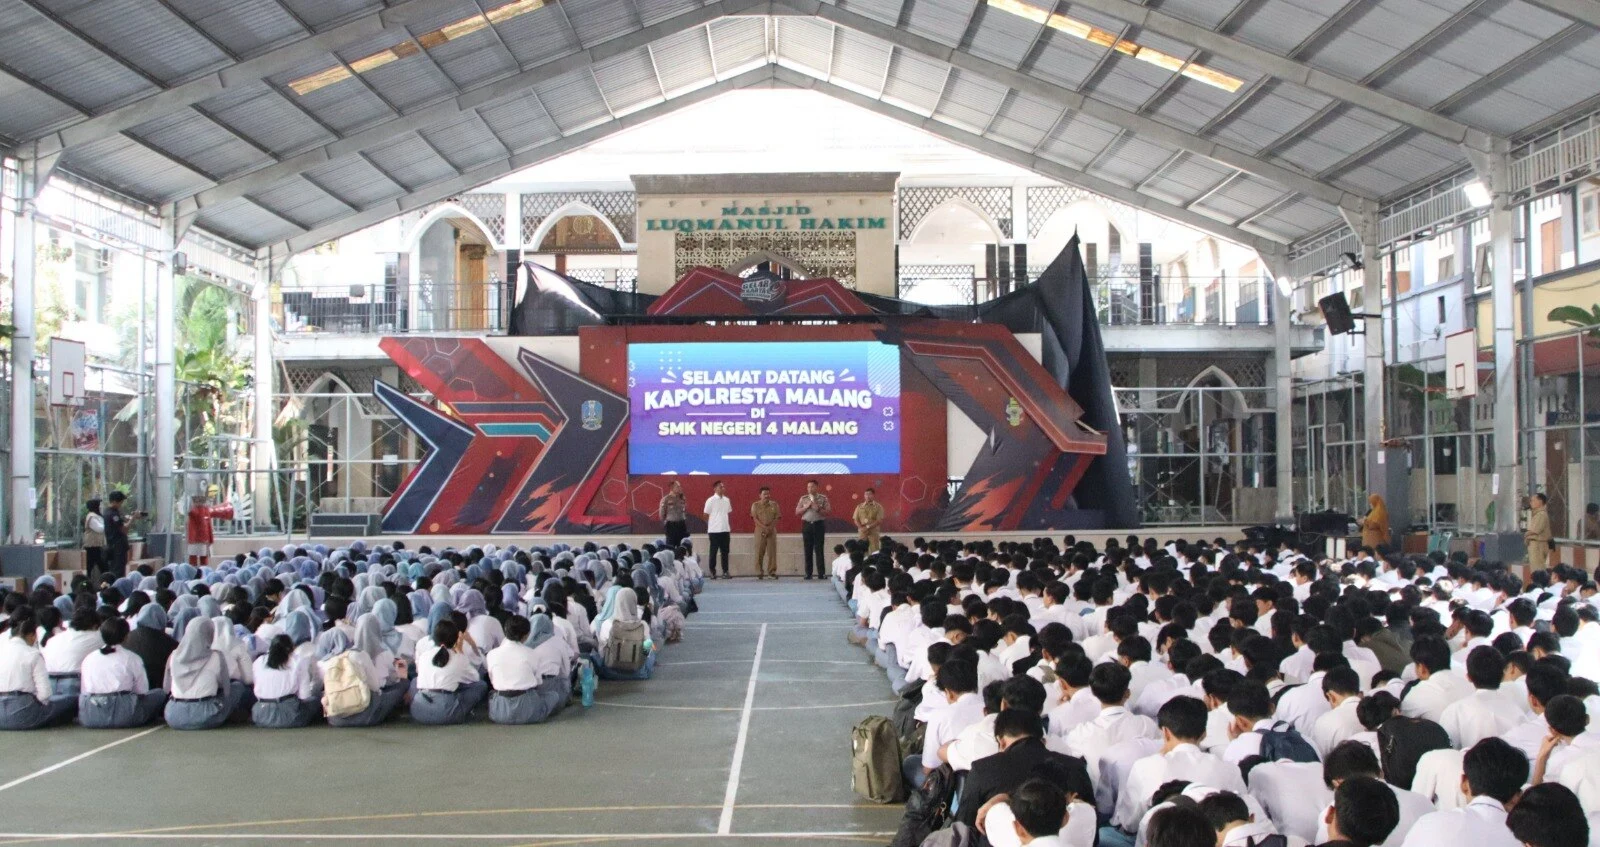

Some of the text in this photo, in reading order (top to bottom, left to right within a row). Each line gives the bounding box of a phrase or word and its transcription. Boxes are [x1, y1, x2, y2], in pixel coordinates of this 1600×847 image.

[722, 206, 812, 216] MASJID
[646, 217, 886, 232] LUQMANUL HAKIM
[682, 370, 835, 385] SELAMAT DATANG
[644, 388, 873, 410] KAPOLRESTA MALANG
[750, 408, 765, 419] DI
[658, 421, 858, 436] SMK NEGERI 4 MALANG
